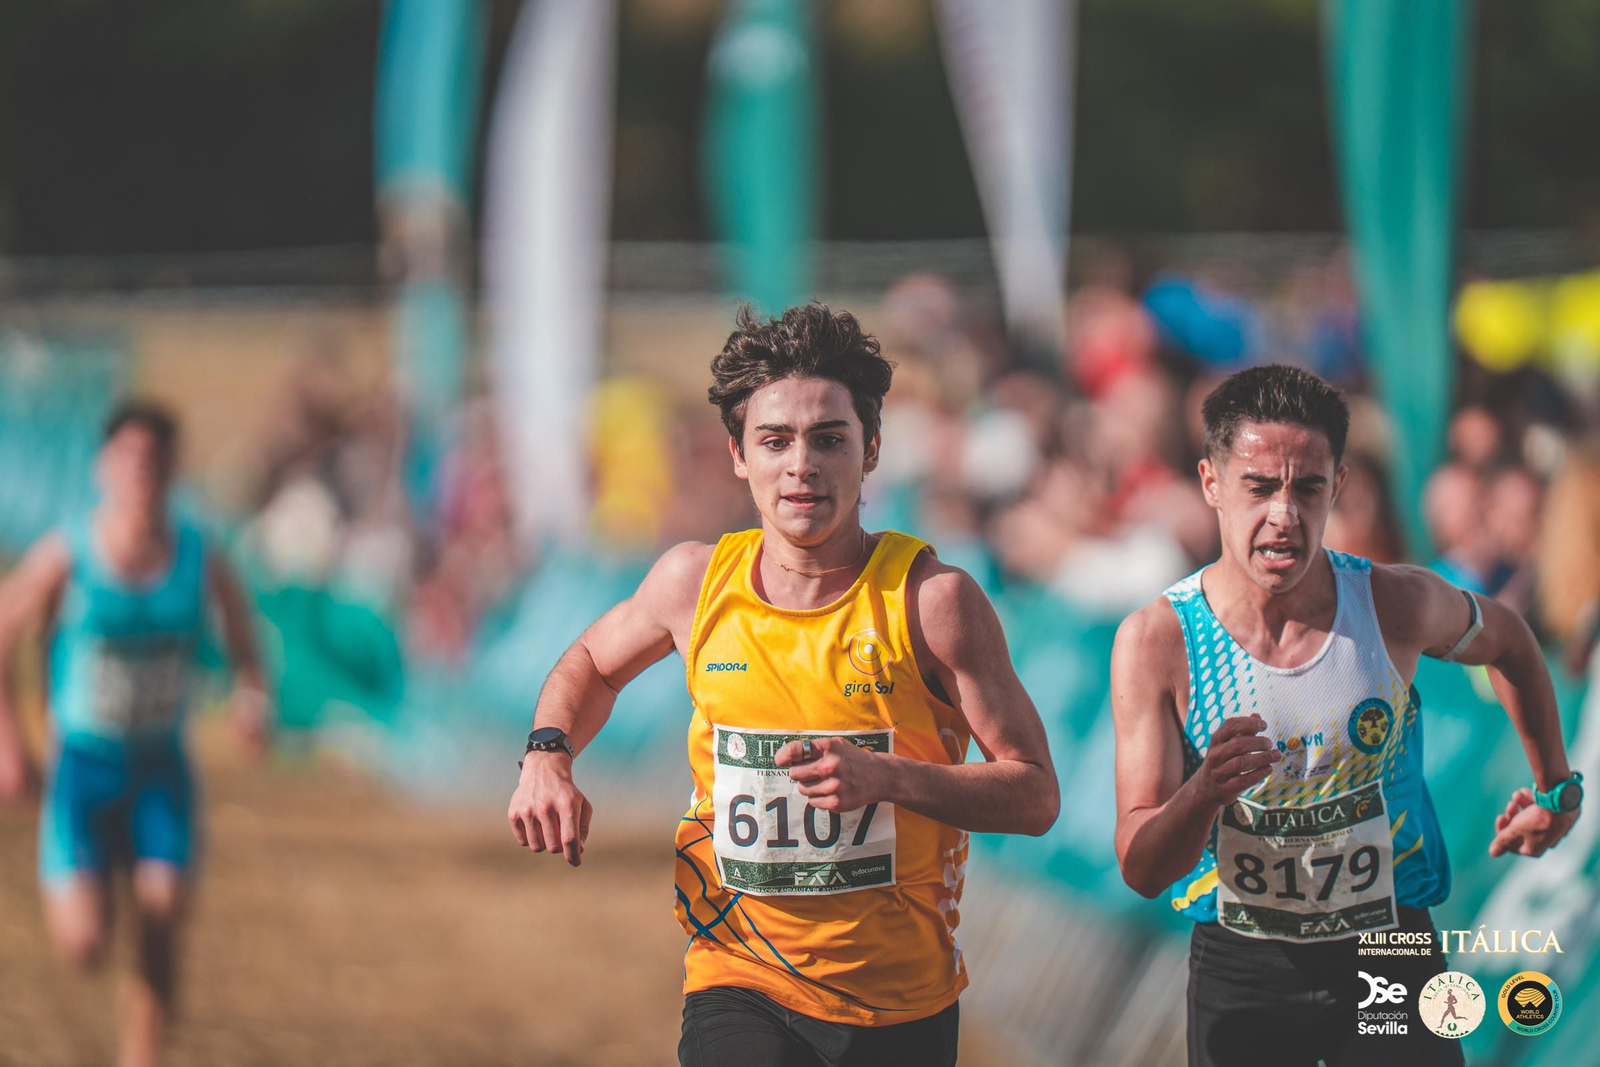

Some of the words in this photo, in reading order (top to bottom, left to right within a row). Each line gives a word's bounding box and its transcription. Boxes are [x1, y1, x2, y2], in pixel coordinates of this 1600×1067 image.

[706, 662, 747, 672] SPIDORA
[844, 680, 871, 697] gira
[1265, 804, 1346, 827] ITÁLICA
[1234, 846, 1380, 901] 8179
